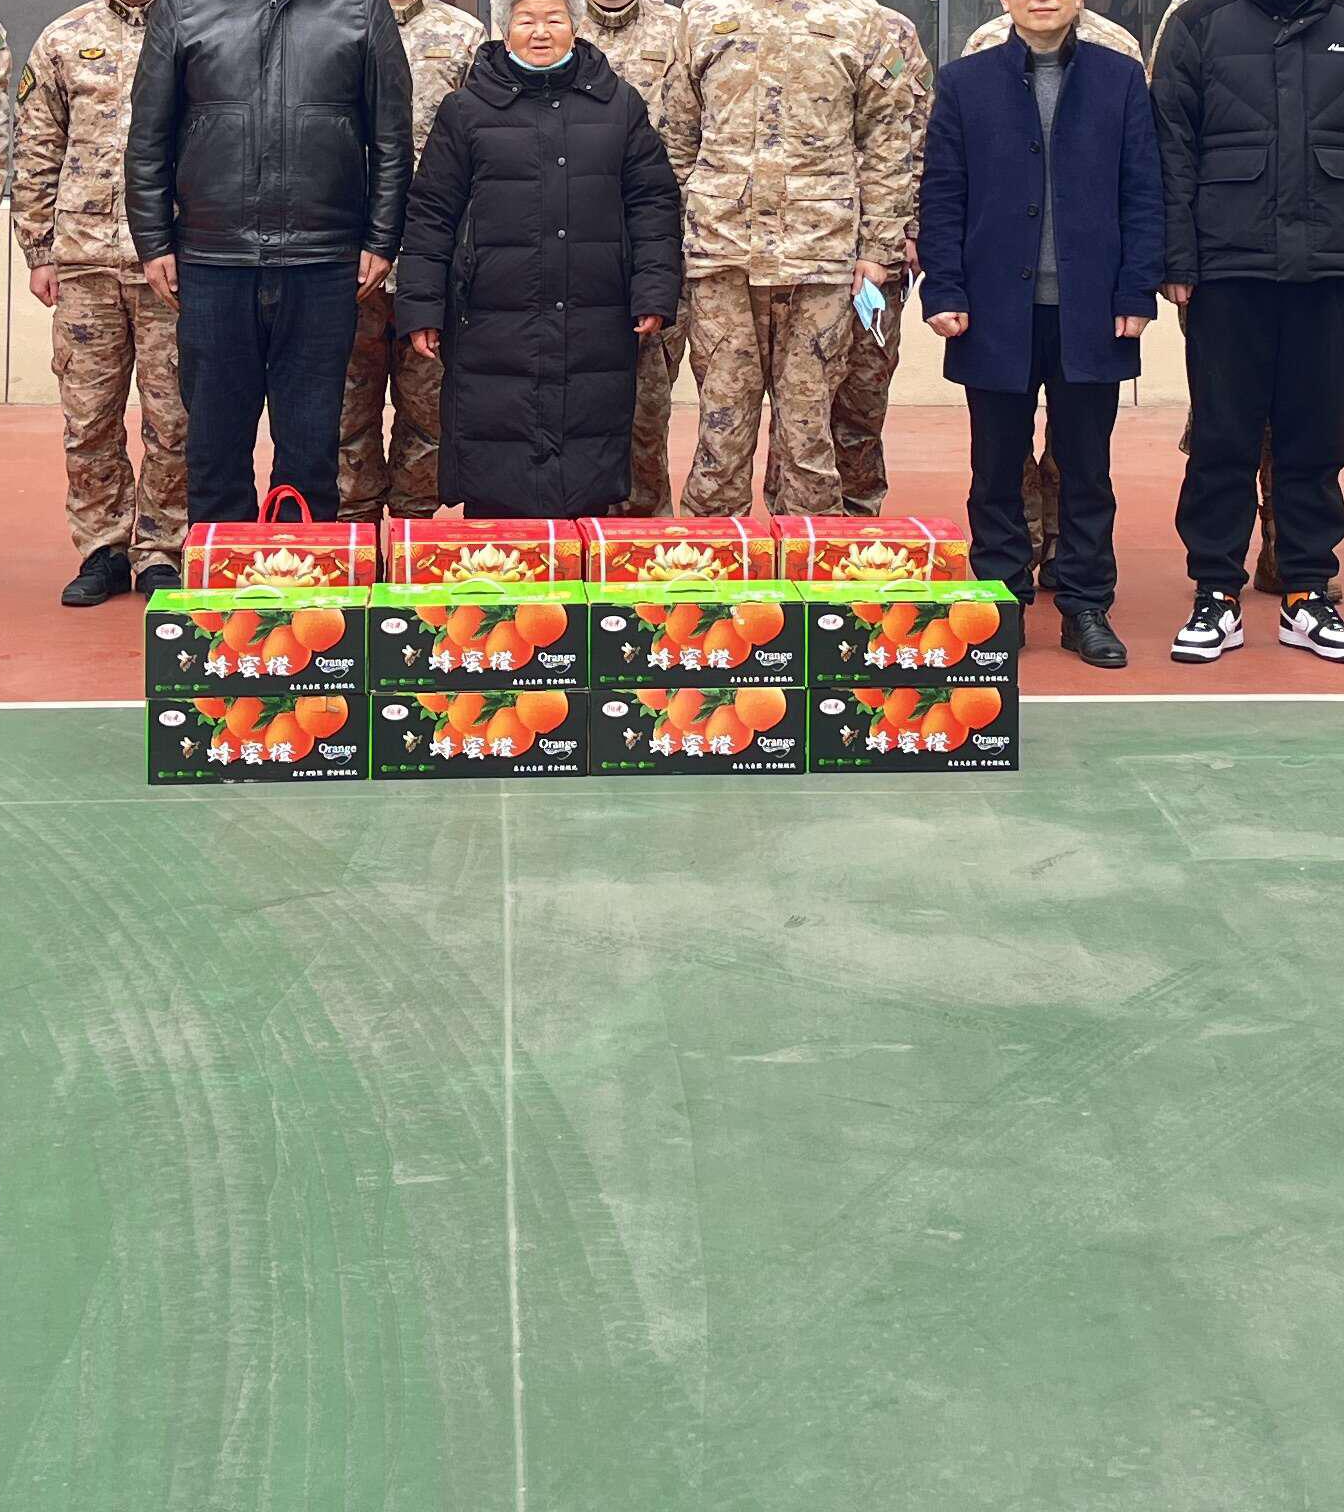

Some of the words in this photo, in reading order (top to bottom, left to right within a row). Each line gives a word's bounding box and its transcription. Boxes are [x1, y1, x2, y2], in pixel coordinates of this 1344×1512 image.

[315, 657, 354, 670] Orange
[428, 649, 516, 674] 蜂蜜橙
[537, 652, 576, 665] Orange
[647, 647, 733, 671] 蜂蜜橙
[755, 650, 793, 663] Orange
[863, 645, 949, 670] 蜂蜜橙
[970, 649, 1009, 662] Orange
[203, 654, 293, 679] 蜂蜜橙
[318, 743, 357, 756] Orange
[428, 735, 517, 761] 蜂蜜橙
[539, 738, 577, 751] Orange
[648, 732, 736, 758] 蜂蜜橙
[757, 736, 795, 749] Orange
[865, 730, 951, 755] 蜂蜜橙
[972, 734, 1010, 747] Orange
[206, 740, 296, 766] 蜂蜜橙
